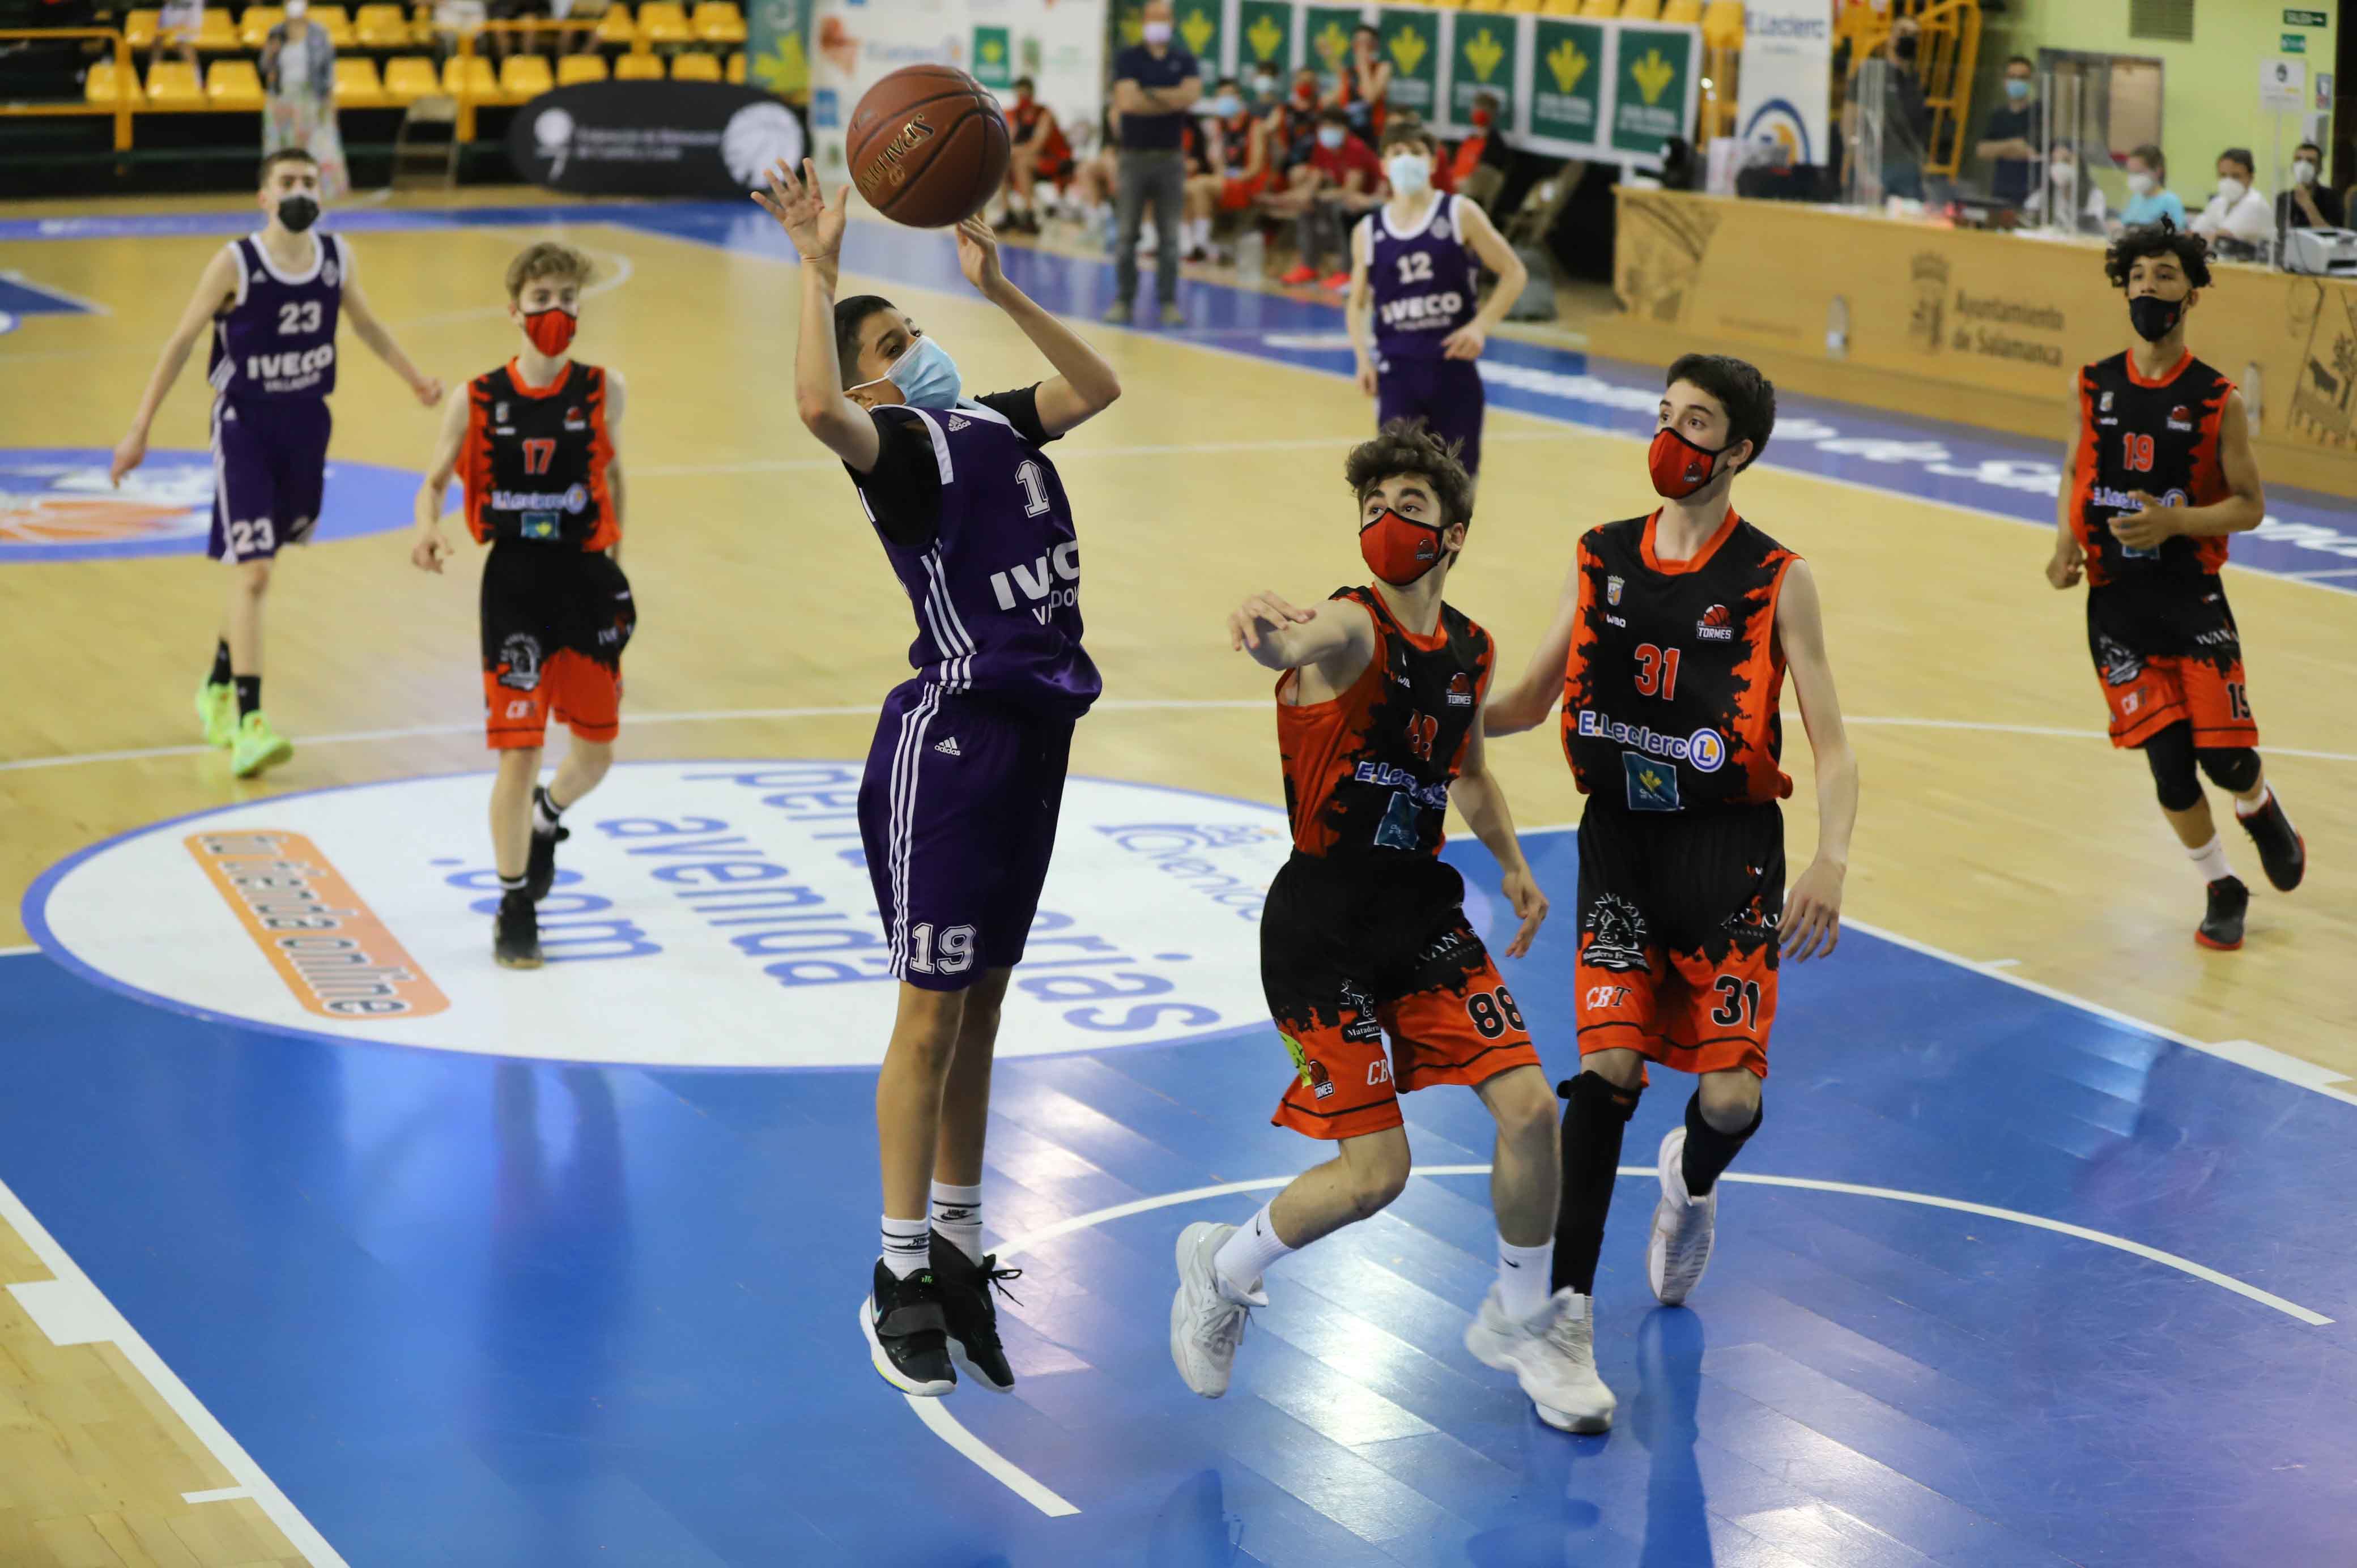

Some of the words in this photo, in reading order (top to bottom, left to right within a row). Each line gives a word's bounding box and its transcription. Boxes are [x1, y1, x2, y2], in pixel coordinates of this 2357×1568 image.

[1396, 250, 1434, 284] 12
[278, 301, 322, 335] 23
[1380, 291, 1463, 326] IVECO
[246, 343, 334, 381] IVECO
[522, 437, 556, 475] 17
[2123, 431, 2155, 472] 19
[231, 518, 275, 553] 23
[990, 540, 1080, 611] IVC
[1699, 627, 1732, 640] TORMES
[1634, 643, 1680, 701] 31
[934, 744, 961, 756] adidas
[1579, 710, 1689, 760] E.Leclerc
[595, 816, 892, 988] avenida
[909, 922, 977, 975] 19
[1466, 985, 1528, 1039] 88
[1586, 986, 1632, 1011] CBT
[1711, 974, 1761, 1032] 31
